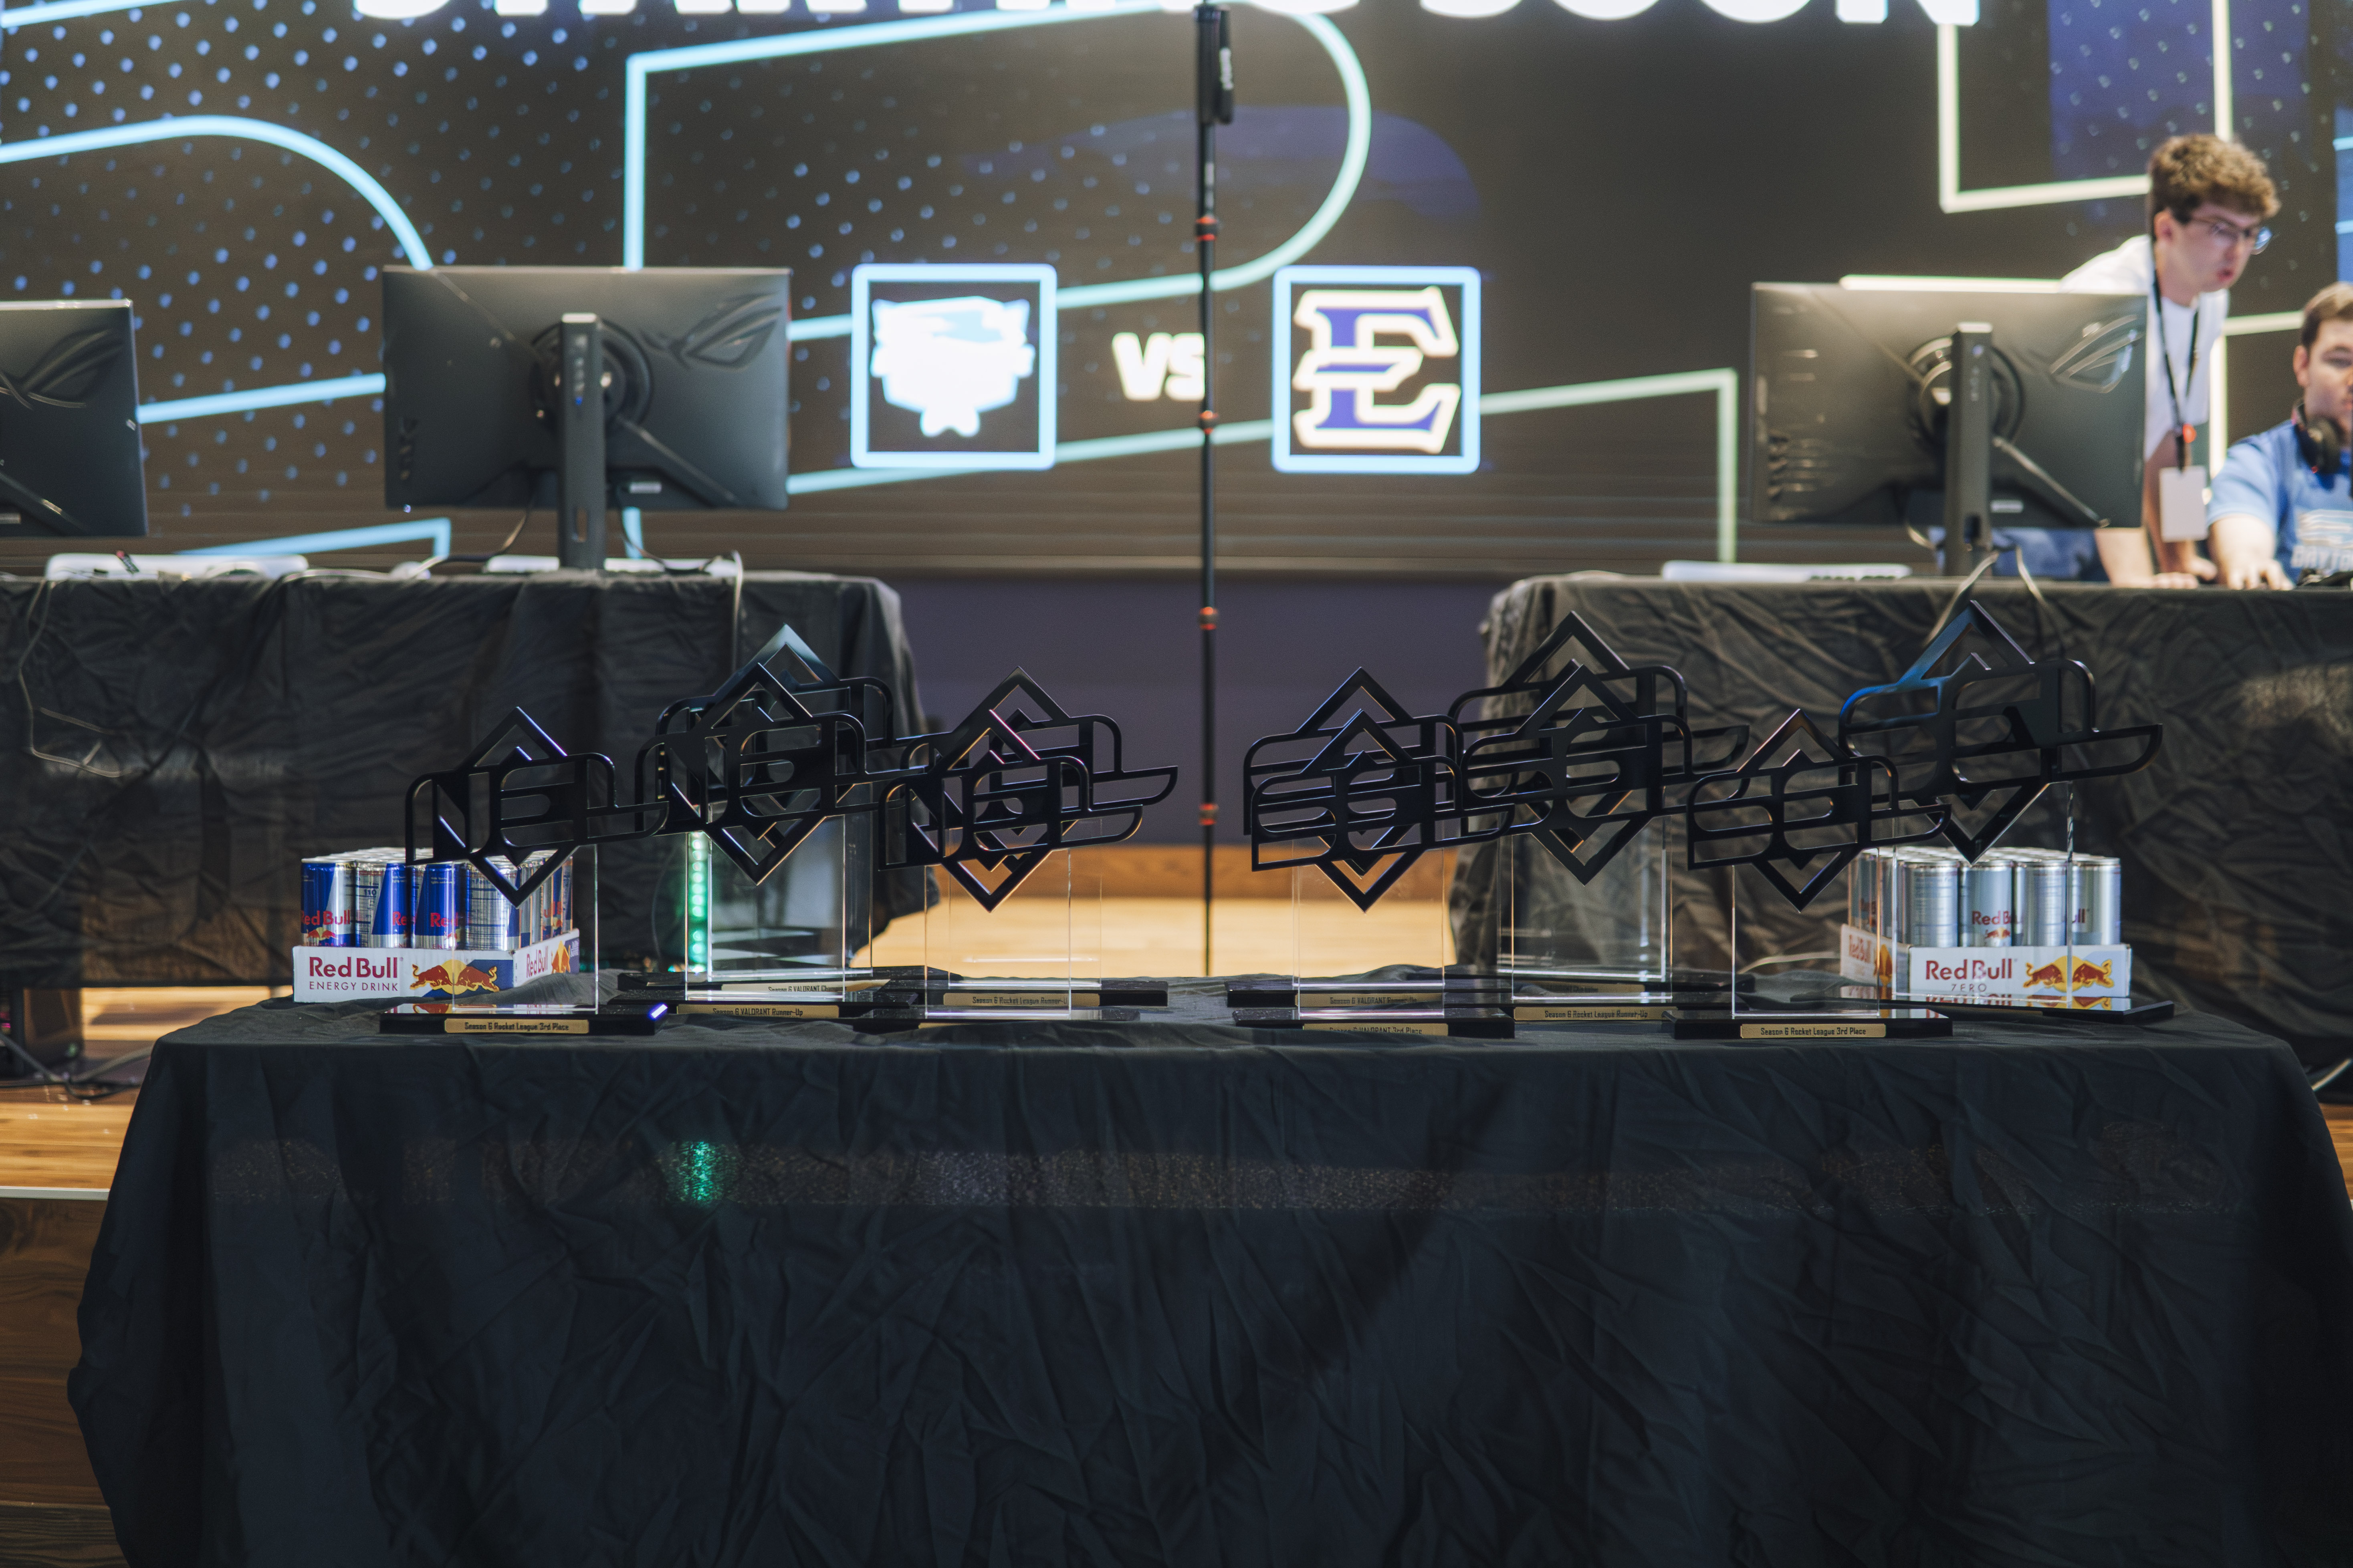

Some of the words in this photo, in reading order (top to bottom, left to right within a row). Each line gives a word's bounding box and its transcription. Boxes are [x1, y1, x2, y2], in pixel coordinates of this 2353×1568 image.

[1112, 332, 1206, 401] VS
[323, 909, 350, 925] Bull
[393, 911, 407, 925] Re
[1972, 911, 2000, 925] Red
[310, 957, 352, 978] Red
[356, 957, 398, 978] Bull
[527, 949, 537, 977] Red
[538, 946, 548, 972] Bull
[1925, 959, 1967, 980] Red
[1972, 958, 2012, 979] Bull
[309, 981, 356, 991] ENERGY
[361, 981, 398, 992] DRINK
[1951, 983, 1987, 992] ZERO
[772, 1008, 803, 1016] Runner-Up
[517, 1023, 537, 1032] League
[1813, 1028, 1835, 1036] League
